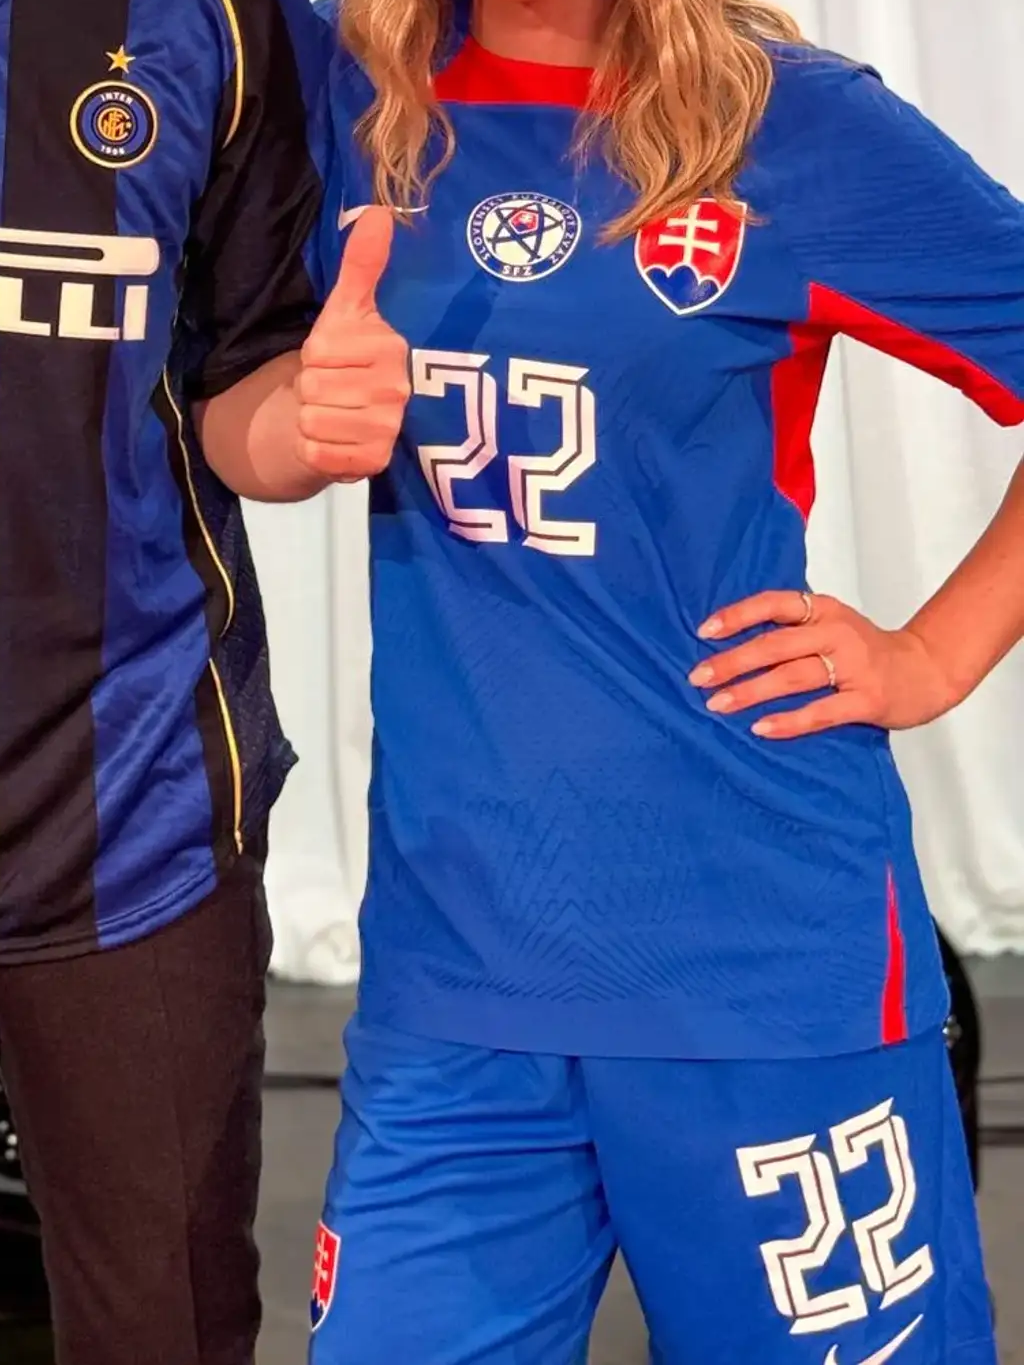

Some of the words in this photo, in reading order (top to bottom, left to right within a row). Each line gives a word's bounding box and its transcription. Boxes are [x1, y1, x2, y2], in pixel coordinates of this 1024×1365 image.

[100, 92, 134, 105] INTER
[502, 265, 533, 276] SFZ
[412, 348, 596, 556] 22
[736, 1097, 934, 1334] 22
